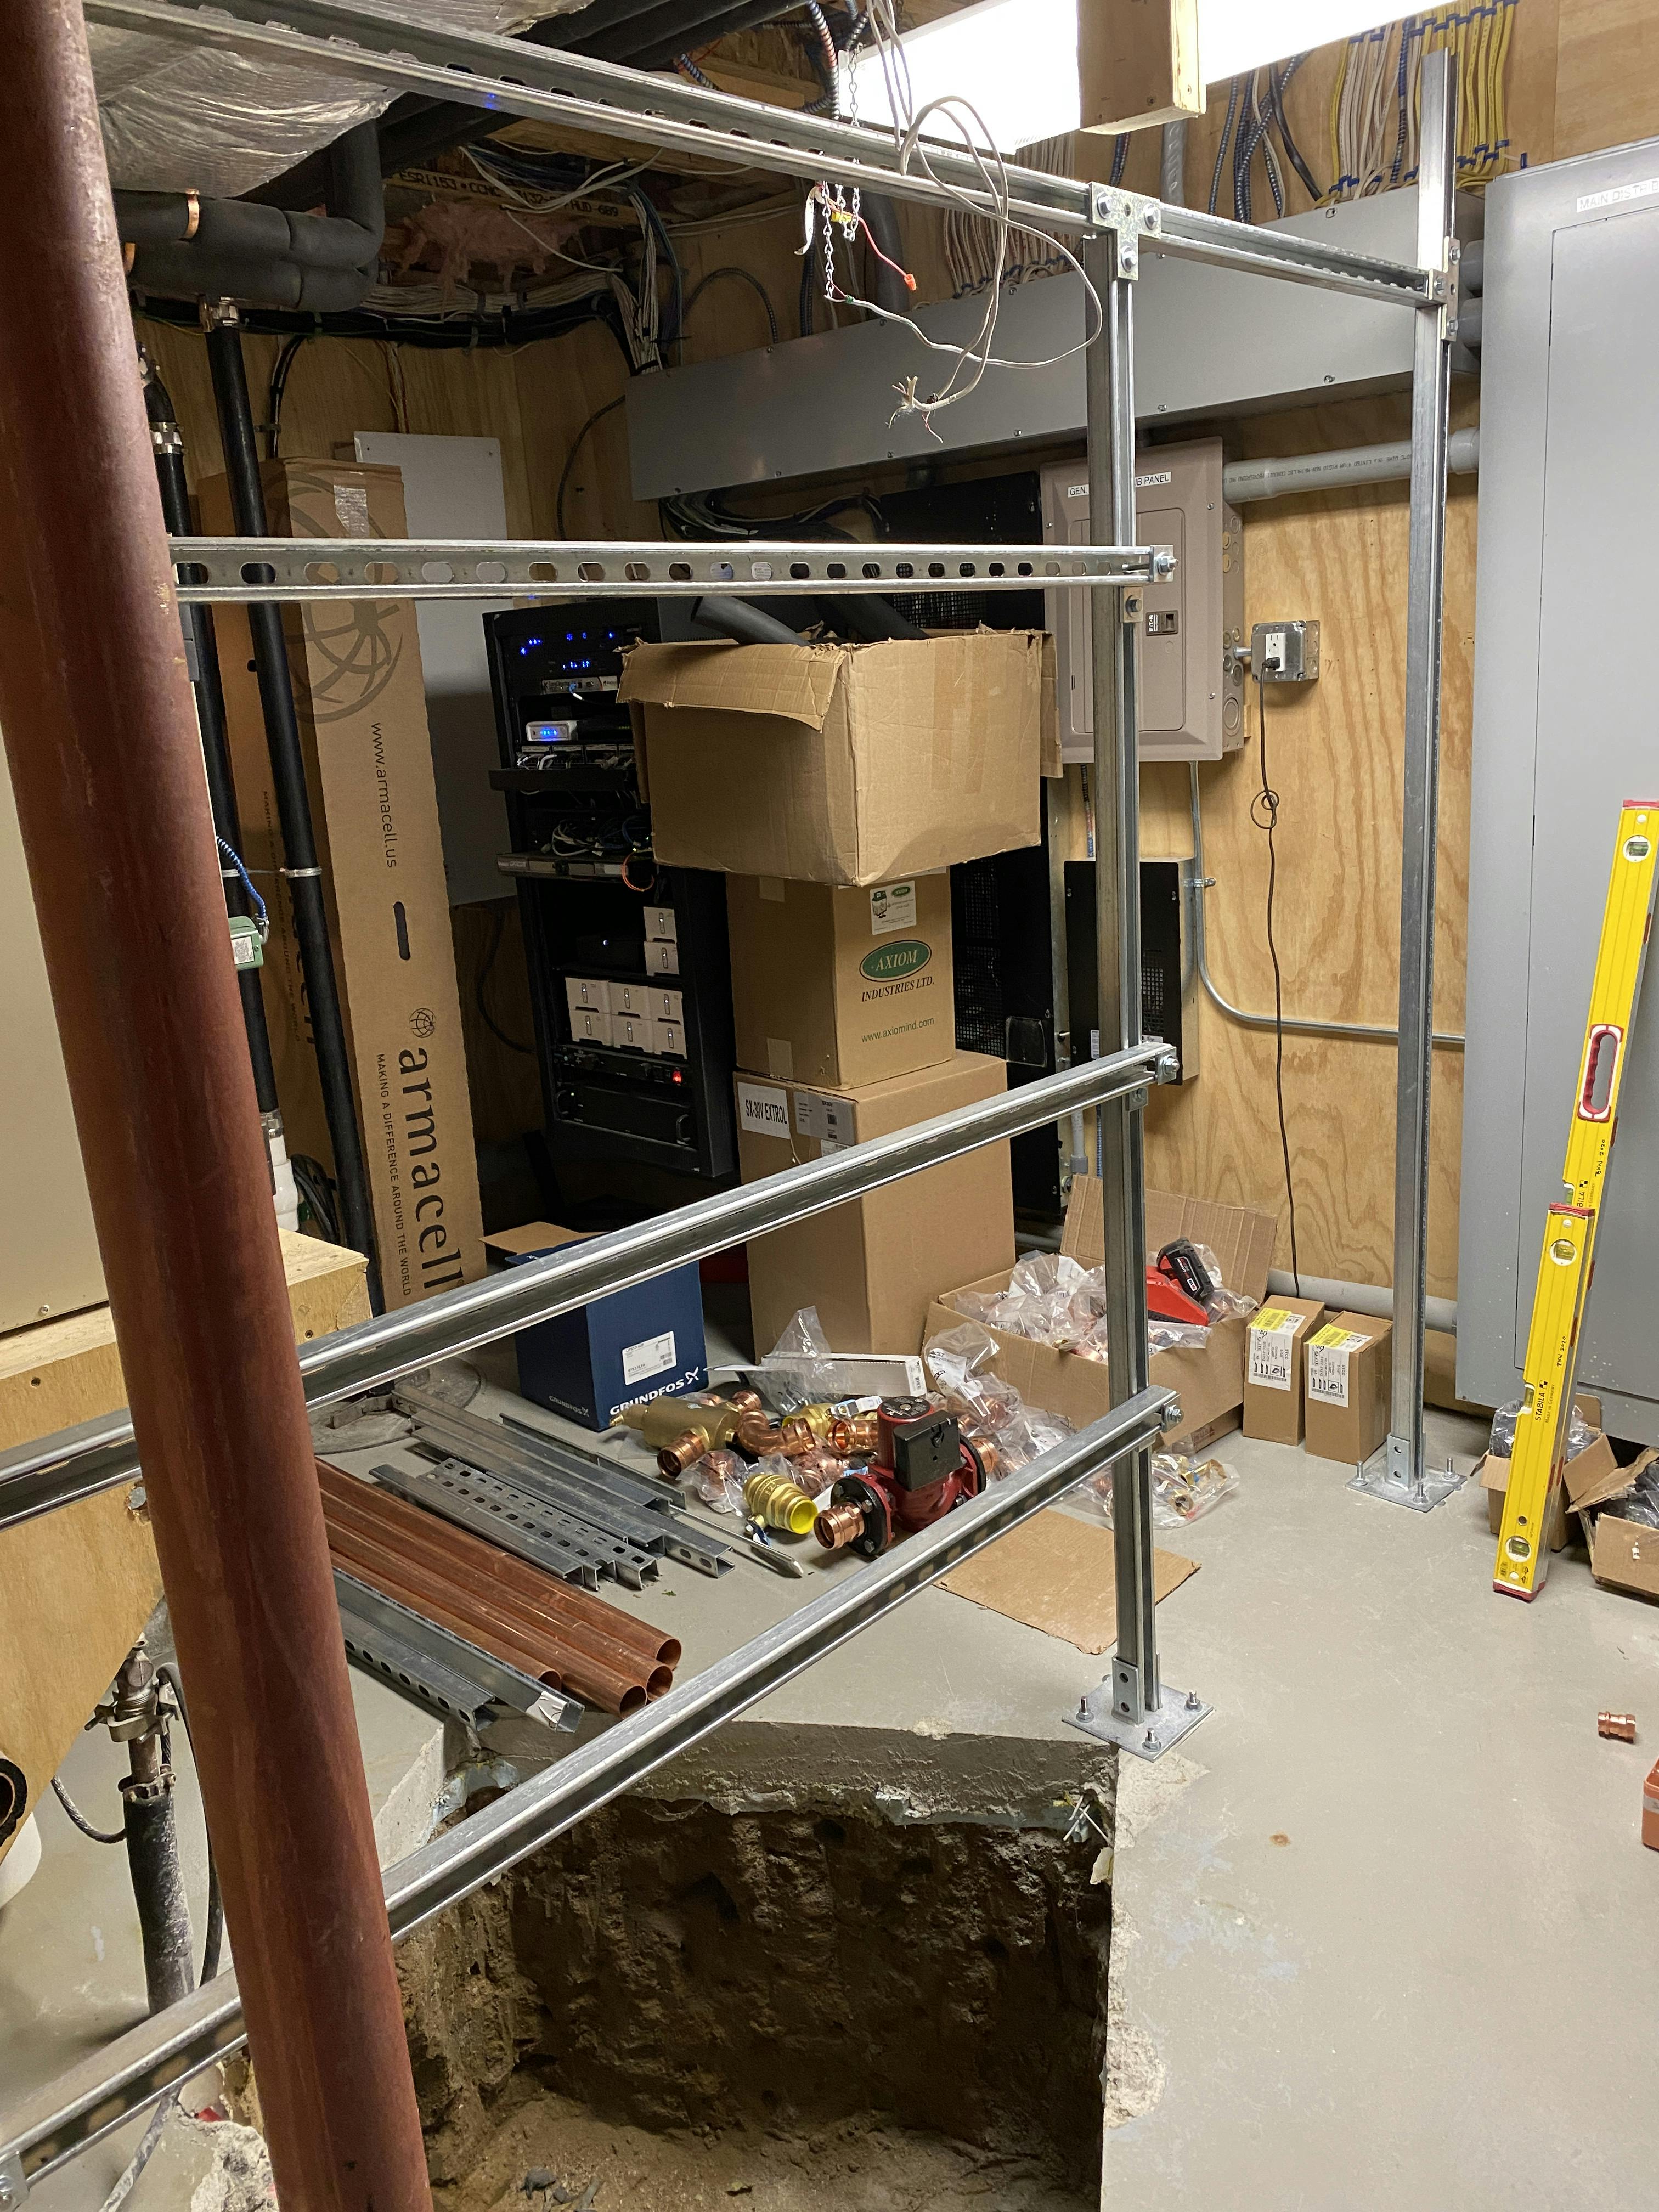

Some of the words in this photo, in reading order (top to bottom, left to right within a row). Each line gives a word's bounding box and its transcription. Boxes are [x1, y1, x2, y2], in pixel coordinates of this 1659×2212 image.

[1580, 193, 1608, 210] MAIN
[1144, 473, 1169, 485] PANEL
[371, 722, 398, 868] www.armacell.us
[876, 950, 918, 971] AXIOM
[861, 980, 915, 1002] INDUSTRIES
[916, 976, 934, 989] LTD.
[861, 1018, 935, 1042] www.axiomind.com
[376, 1053, 389, 1097] MAKING
[746, 1099, 764, 1120] SX-30V
[765, 1103, 787, 1124] EXTROL
[383, 1113, 399, 1182] DIFFERENCE
[398, 1047, 464, 1289] armacell
[392, 1186, 404, 1230] AROUND
[397, 1233, 407, 1255] THE
[400, 1257, 411, 1296] WORLD
[549, 1395, 583, 1414] GRUNDFOS
[610, 1378, 685, 1416] GRUNDFOS
[1535, 1392, 1545, 1421] STABILA
